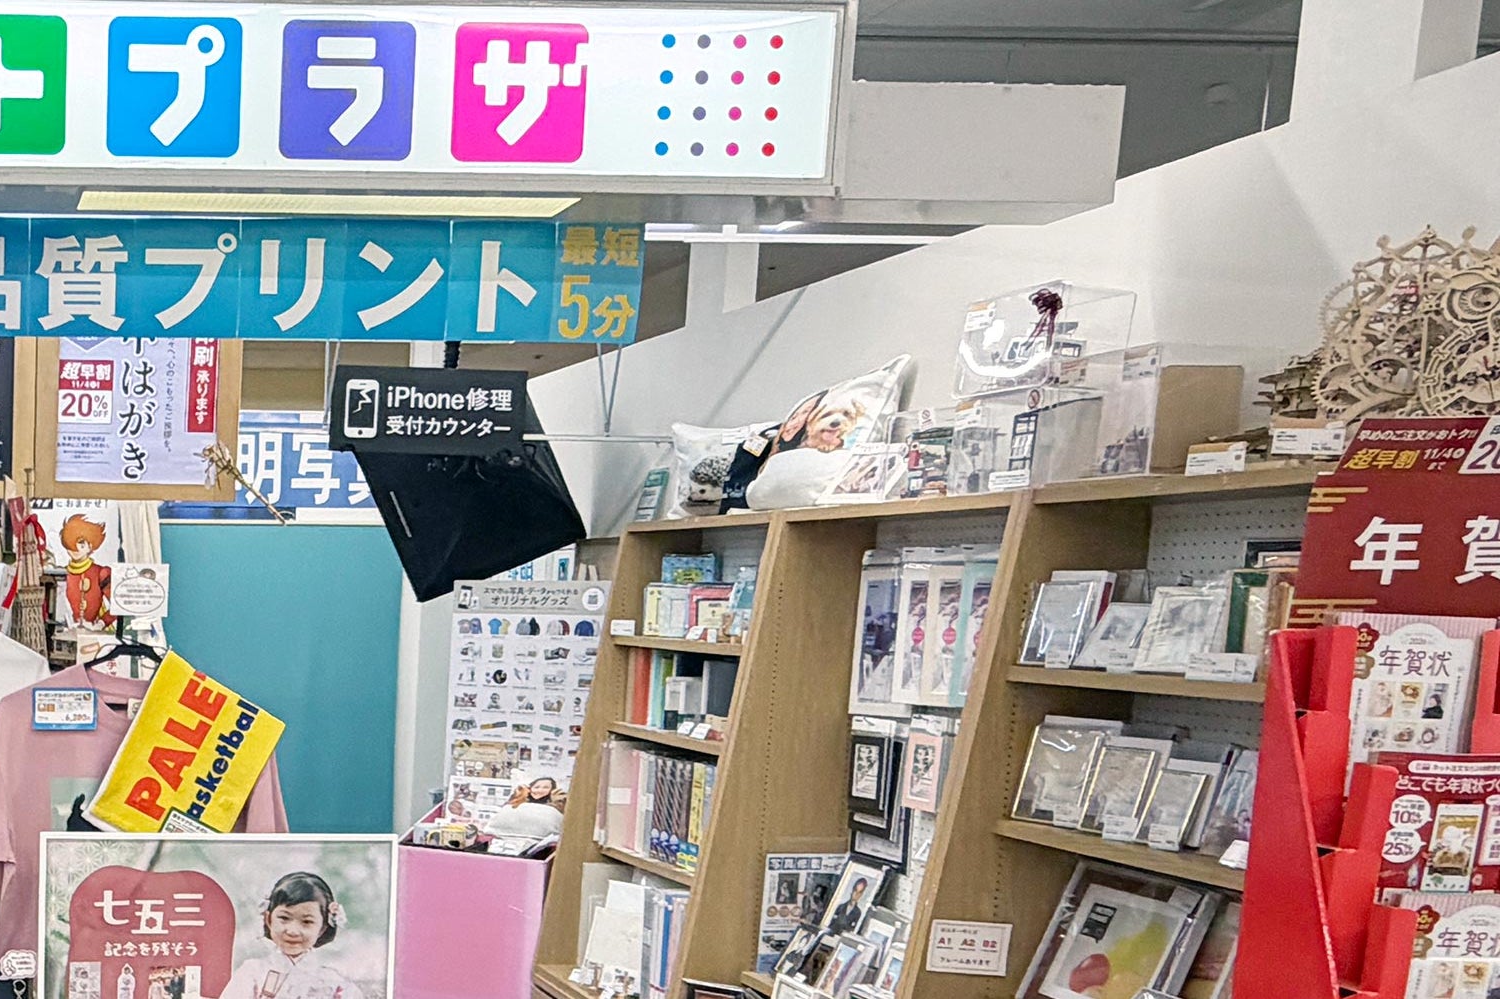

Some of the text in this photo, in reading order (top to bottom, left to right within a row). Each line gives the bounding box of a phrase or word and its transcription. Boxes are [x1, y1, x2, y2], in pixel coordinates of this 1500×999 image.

[560, 226, 640, 267] 最短
[558, 274, 636, 340] 5分
[60, 361, 111, 381] 超早割
[386, 385, 513, 412] iPhone修理
[385, 415, 511, 437] 受付カウンター
[1342, 448, 1420, 470] 超早割
[491, 596, 570, 606] オリジナルグッズ
[1378, 645, 1453, 677] 年賀状
[94, 889, 206, 935] 七五三
[103, 941, 199, 958] 記念を残そう
[960, 938, 976, 947] A2
